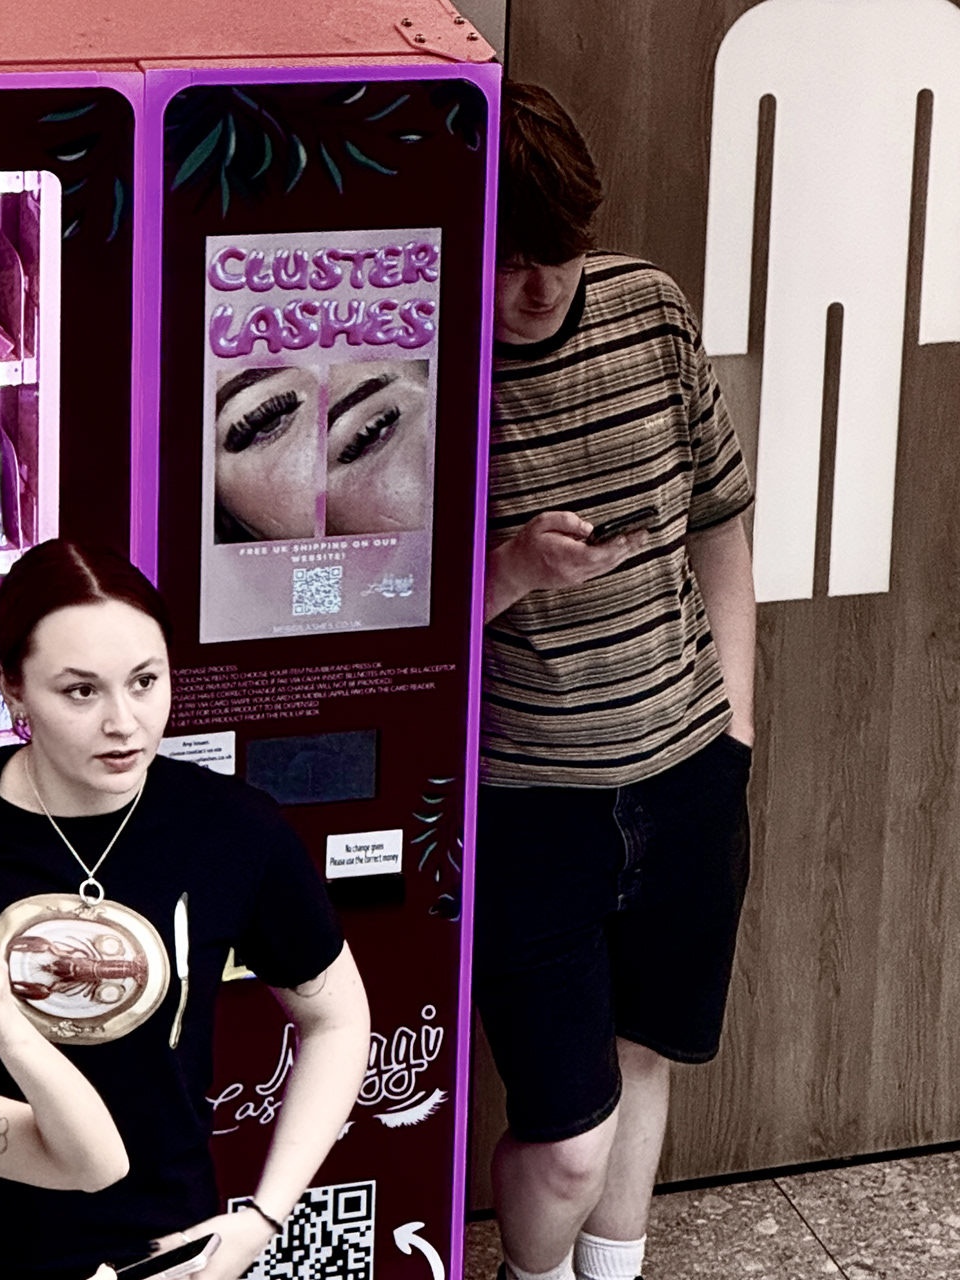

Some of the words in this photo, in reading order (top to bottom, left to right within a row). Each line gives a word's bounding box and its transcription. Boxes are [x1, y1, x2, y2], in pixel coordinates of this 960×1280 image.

[209, 243, 439, 292] CLUSTER
[209, 300, 437, 358] LASHES
[240, 547, 268, 556] FREE
[273, 545, 288, 553] UK
[293, 542, 348, 552] SHIPPING
[373, 538, 397, 546] OUR
[207, 664, 237, 673] PROCESS
[239, 670, 267, 679] CHOOSE
[269, 669, 287, 677] YOUR
[351, 662, 371, 670] PRESS
[216, 689, 246, 698] CORRECT
[286, 683, 314, 692] CHANGE
[409, 682, 436, 691] READER
[211, 714, 243, 724] PRODUCT
[243, 713, 264, 721] FROM
[265, 711, 278, 719] THE
[305, 708, 319, 716] BOX
[230, 704, 262, 713] PRODUCT
[345, 844, 352, 853] No
[352, 844, 370, 857] change
[371, 843, 384, 854] given
[330, 857, 346, 866] Please
[355, 855, 363, 864] the
[364, 854, 382, 863] correct
[382, 854, 399, 864] money
